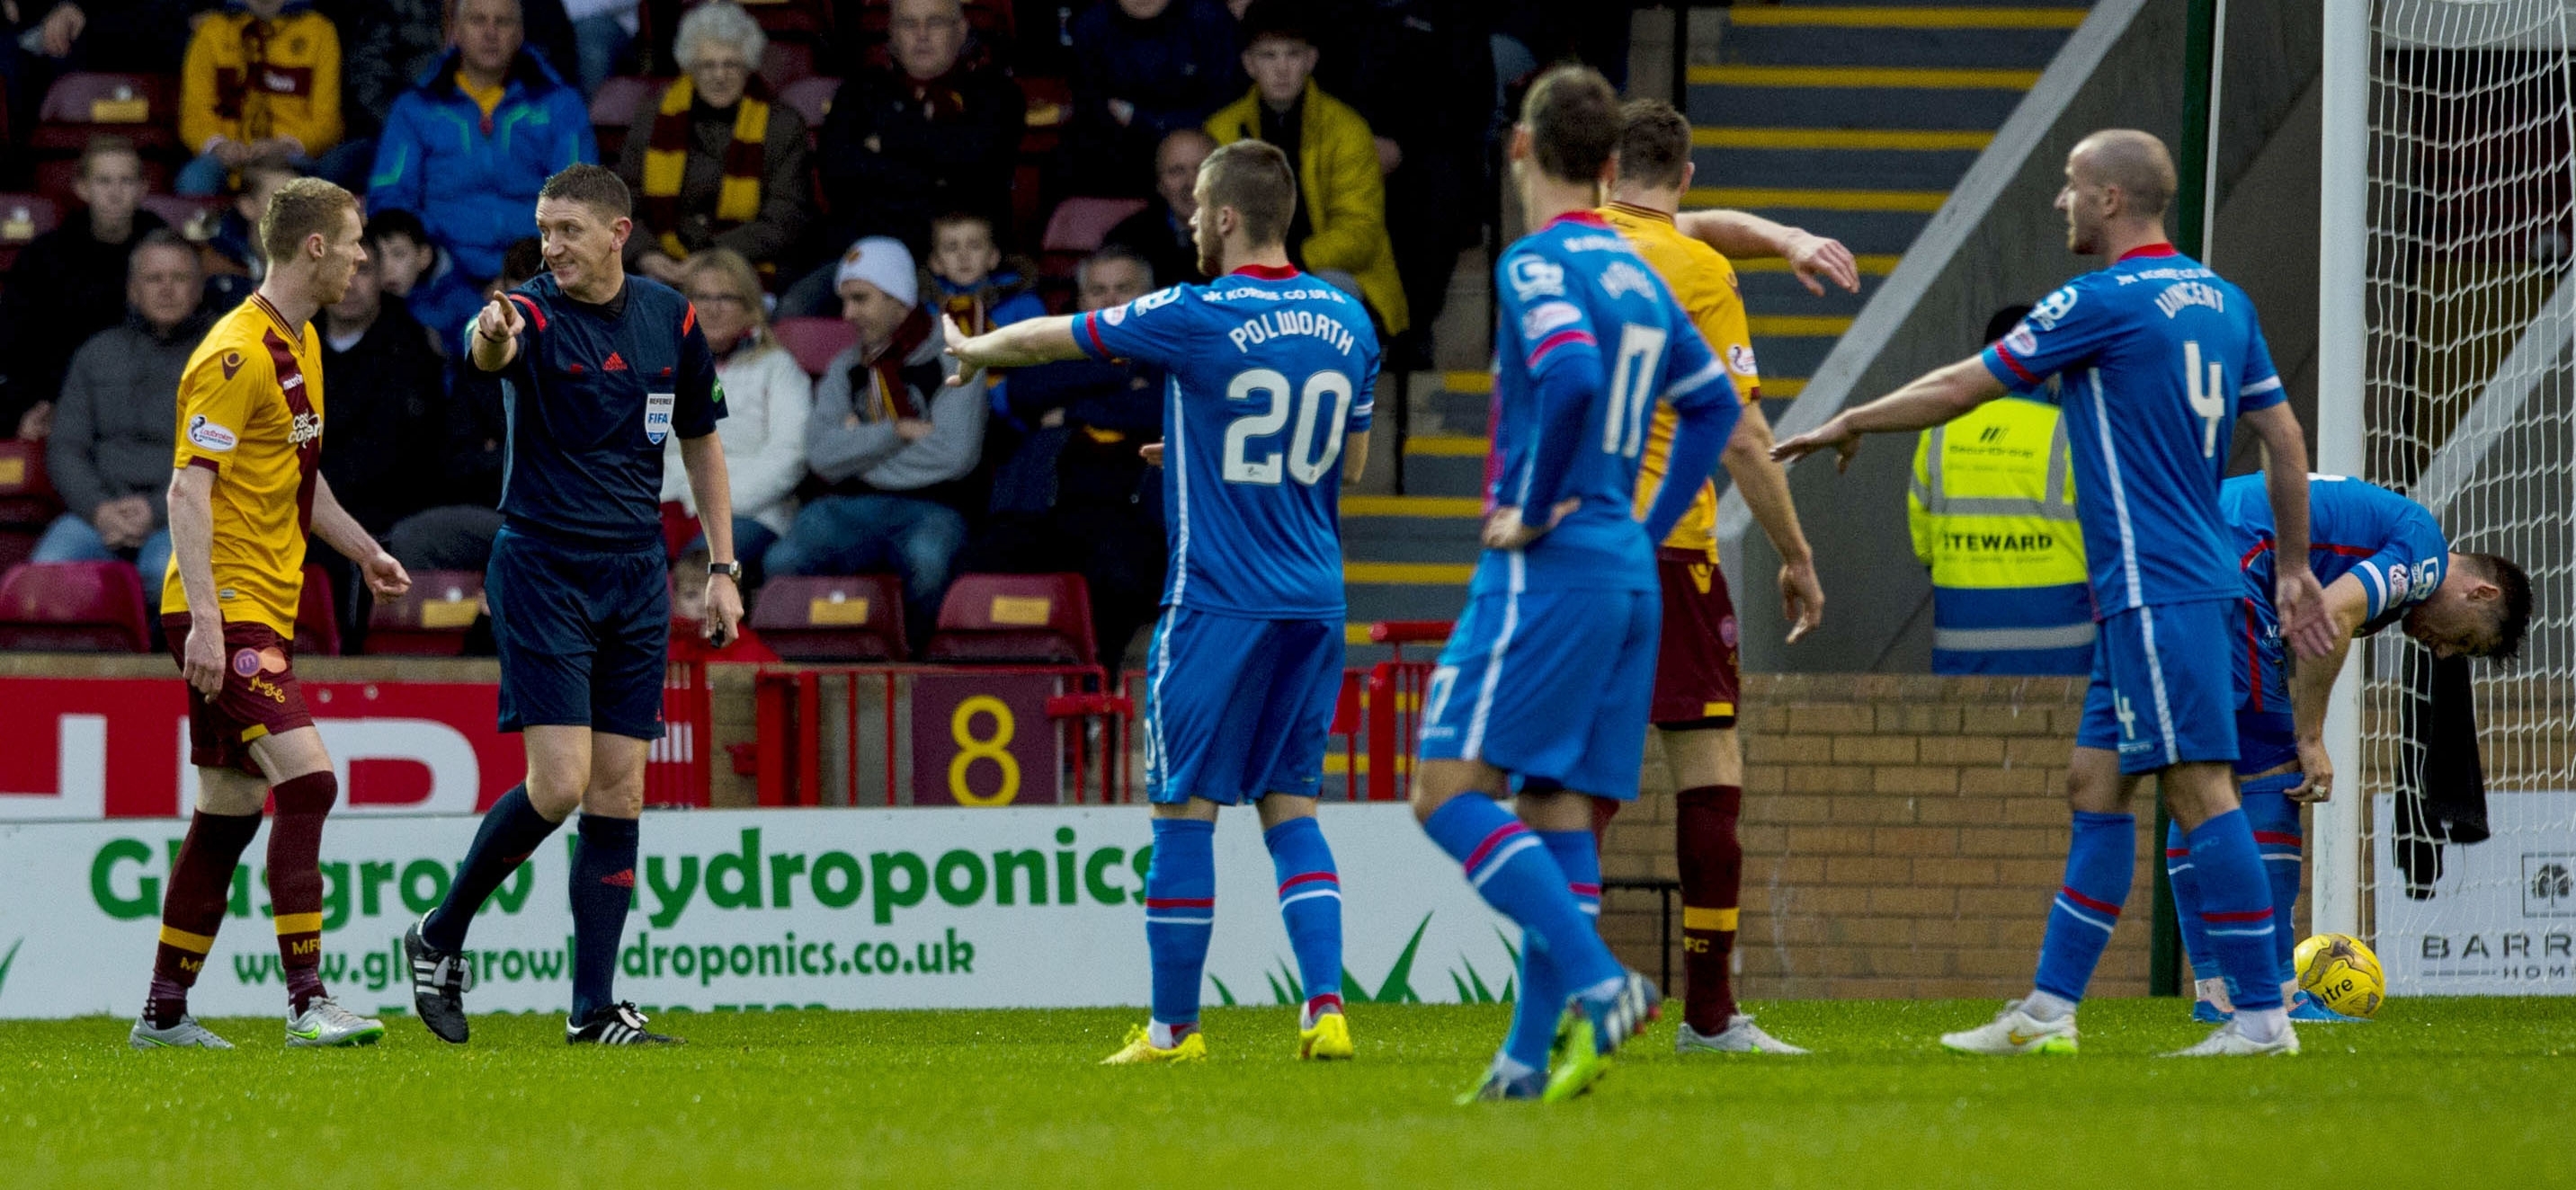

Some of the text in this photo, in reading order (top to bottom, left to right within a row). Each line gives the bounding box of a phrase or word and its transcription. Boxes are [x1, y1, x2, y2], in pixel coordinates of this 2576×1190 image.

[1228, 310, 1355, 356] POLWORTH
[2154, 281, 2224, 320] VINCENT
[647, 413, 669, 424] FIFA
[1602, 324, 1667, 458] 17
[2183, 340, 2225, 458] 4
[1223, 367, 1353, 485] 20
[2112, 688, 2136, 741] 4
[948, 694, 1021, 807] 8
[91, 826, 1150, 932] Gagrow ydroponic
[234, 927, 976, 992] ww.glrowdroponics.co.uk
[2421, 934, 2572, 960] BARR
